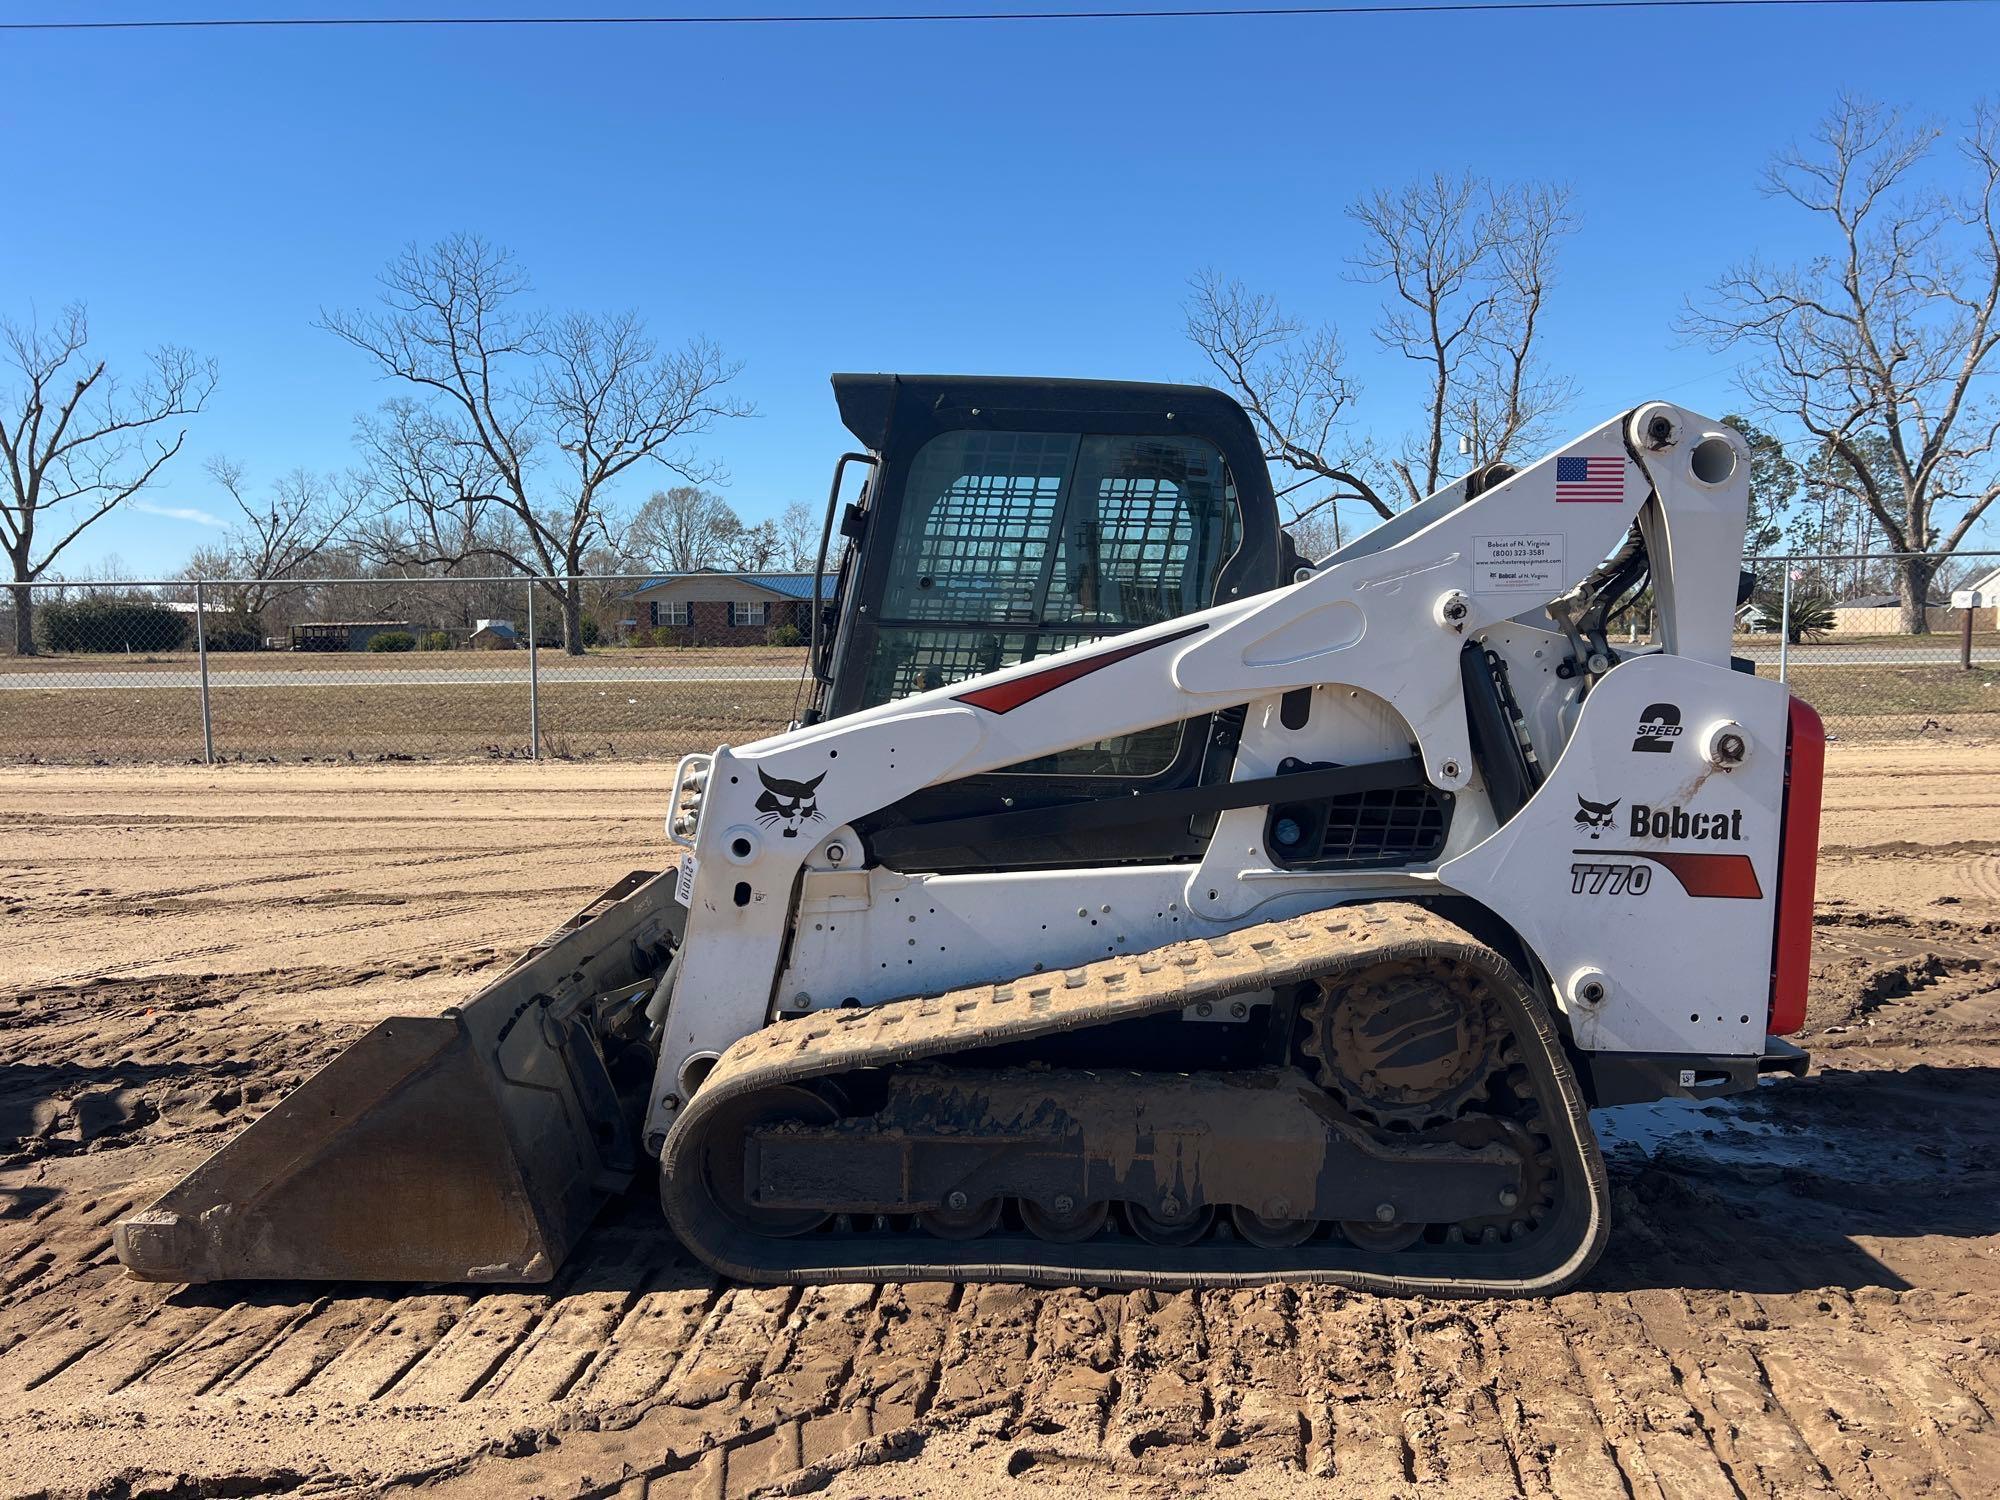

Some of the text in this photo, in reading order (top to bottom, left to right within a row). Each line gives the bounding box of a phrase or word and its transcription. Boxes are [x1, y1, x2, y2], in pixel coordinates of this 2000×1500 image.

[1492, 549, 1544, 557] (800) 323-3581
[1526, 540, 1550, 549] Virginia
[1632, 703, 1681, 753] 2
[1636, 724, 1683, 737] SPEED
[1630, 804, 1743, 841] Bobcat
[681, 864, 694, 900] 211010
[1571, 863, 1652, 896] T770
